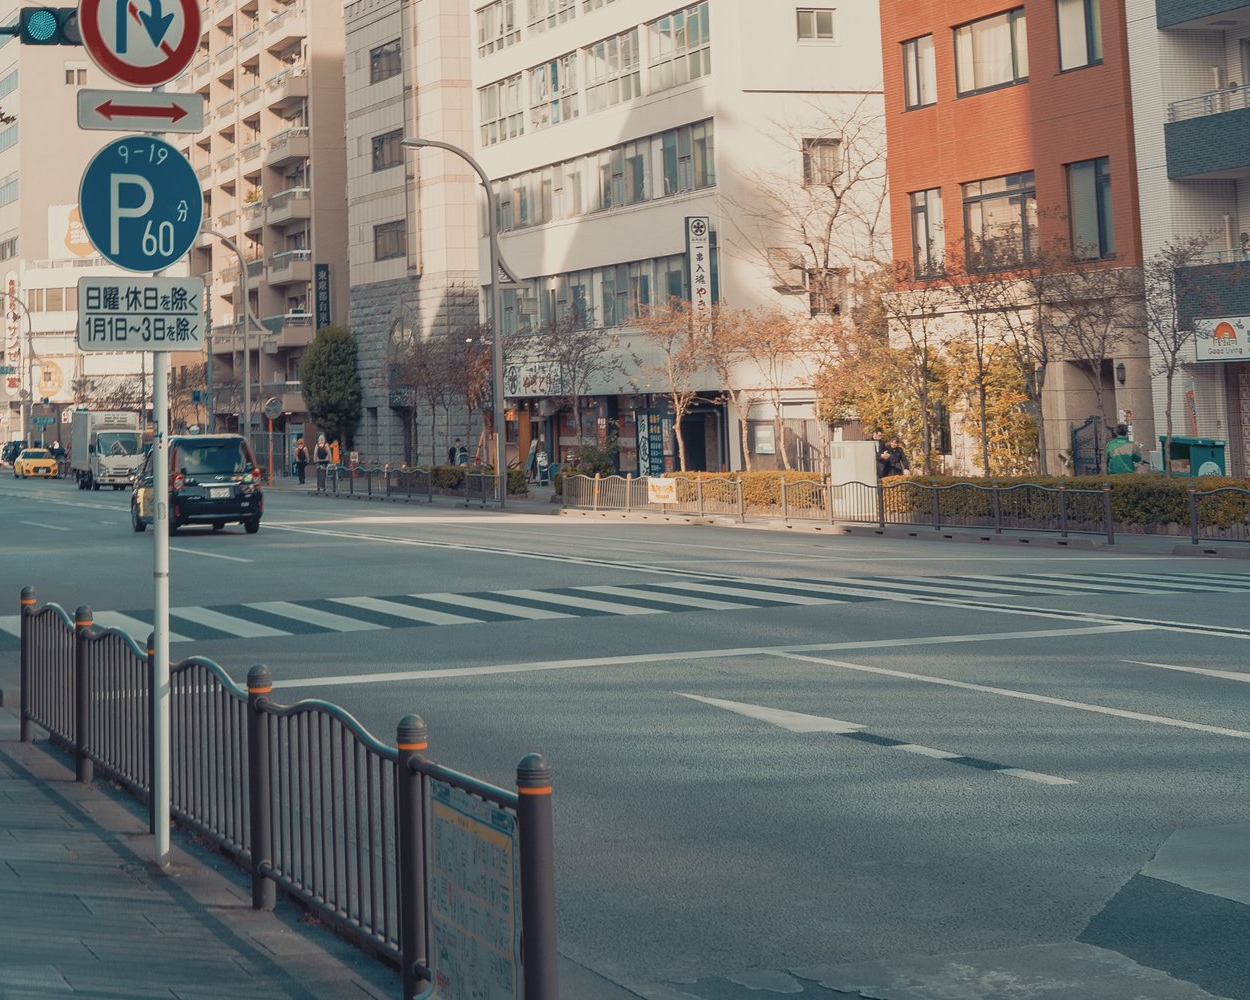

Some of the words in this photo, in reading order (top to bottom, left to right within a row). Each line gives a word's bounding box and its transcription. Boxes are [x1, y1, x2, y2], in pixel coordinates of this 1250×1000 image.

[110, 173, 155, 255] P
[177, 200, 189, 222] 分
[142, 220, 175, 257] 60
[1208, 347, 1224, 355] Good
